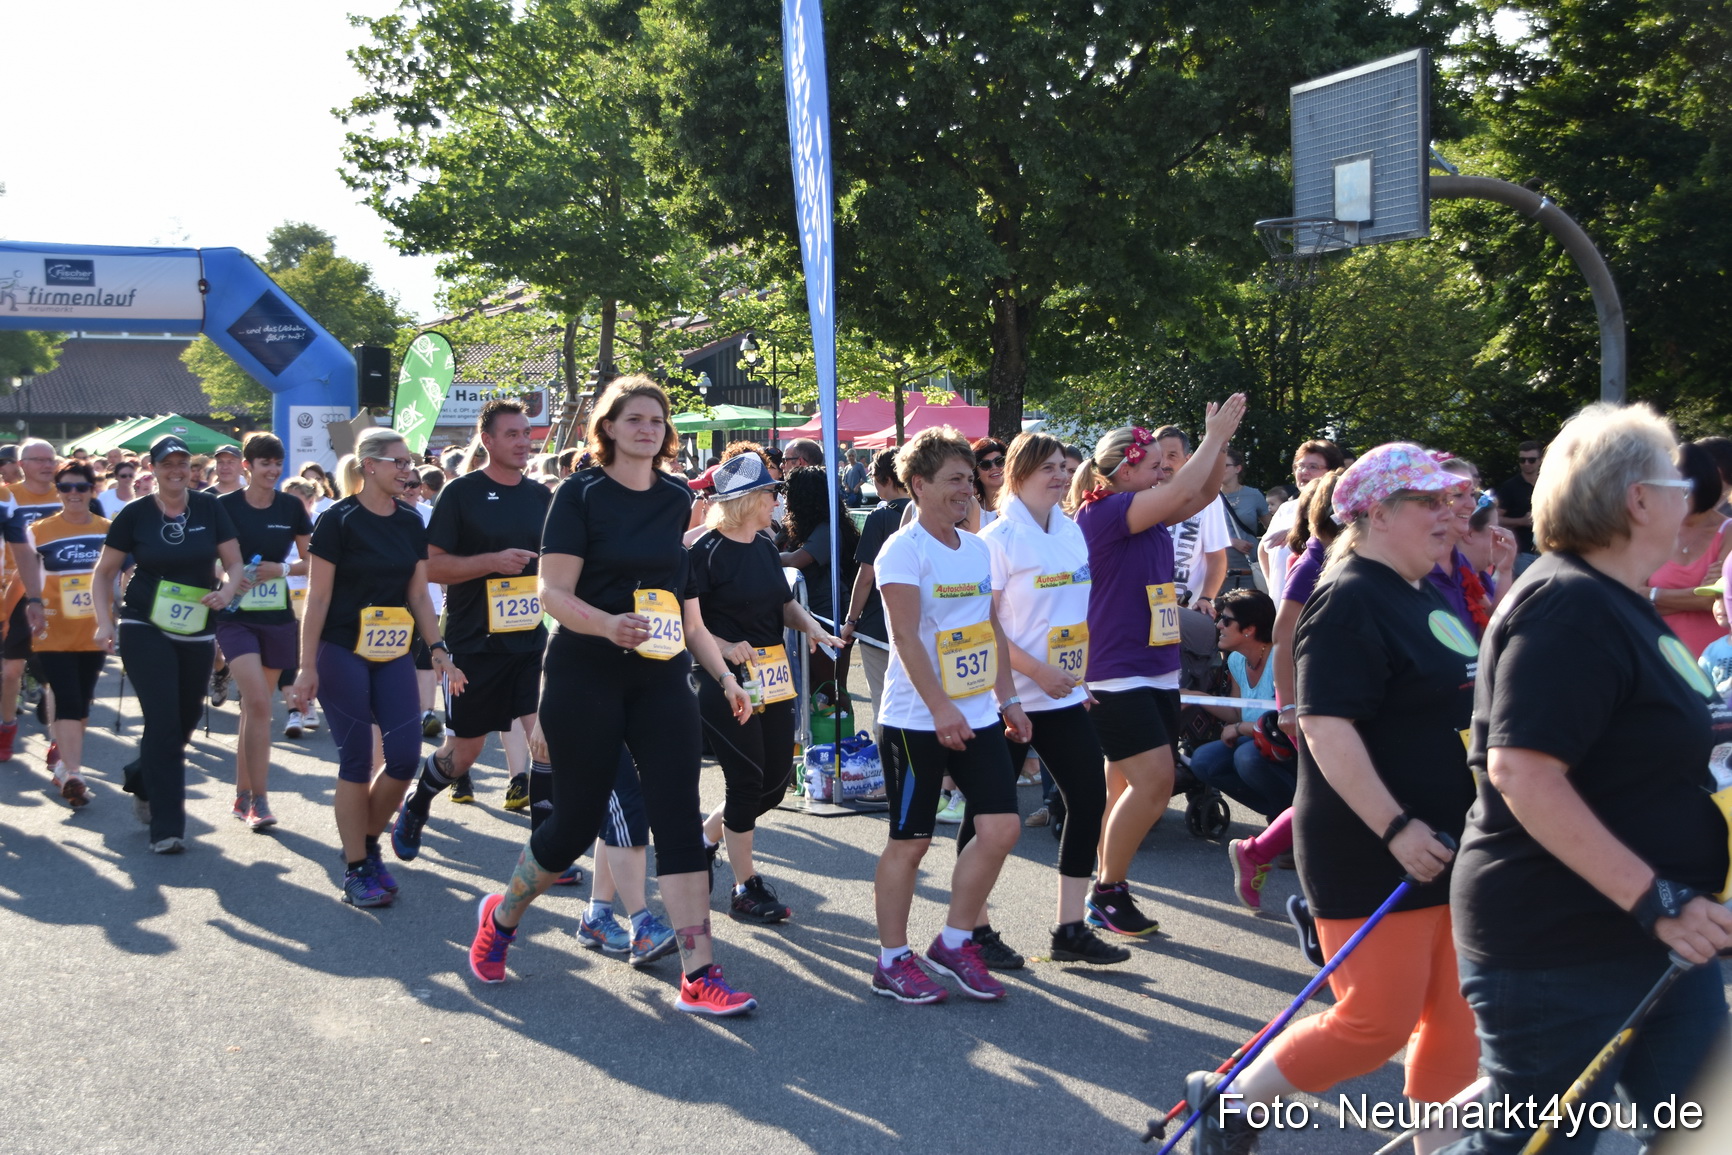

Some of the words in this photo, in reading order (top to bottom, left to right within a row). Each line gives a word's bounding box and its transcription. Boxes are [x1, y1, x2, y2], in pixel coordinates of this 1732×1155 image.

[56, 269, 93, 277] Fischer
[28, 286, 137, 307] firmenlauf
[28, 305, 74, 313] neumarkt
[67, 550, 101, 559] Fisch
[936, 583, 976, 593] Autoschilder
[170, 603, 194, 621] 97
[496, 597, 540, 617] 1236
[1159, 606, 1178, 628] 701
[366, 629, 408, 647] 1232
[646, 616, 682, 642] 245
[956, 649, 988, 678] 537
[1058, 648, 1083, 671] 538
[758, 664, 789, 688] 1246
